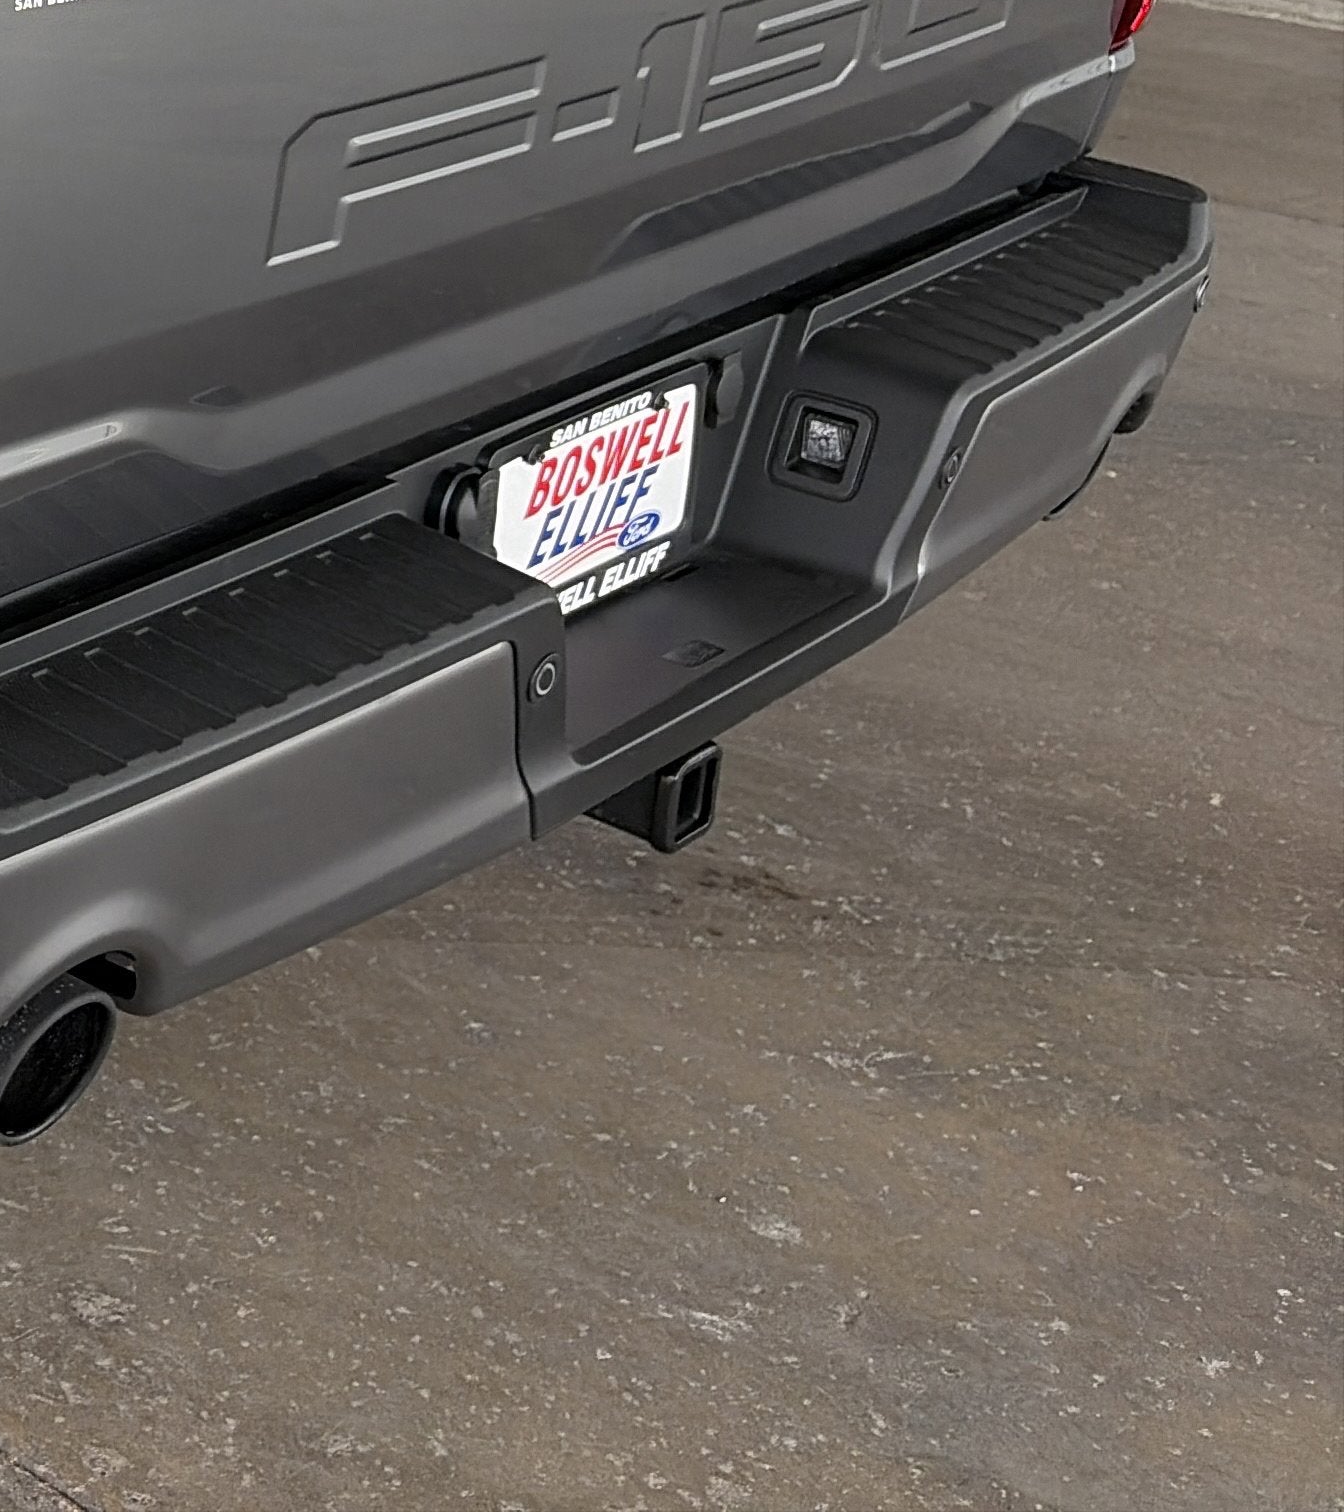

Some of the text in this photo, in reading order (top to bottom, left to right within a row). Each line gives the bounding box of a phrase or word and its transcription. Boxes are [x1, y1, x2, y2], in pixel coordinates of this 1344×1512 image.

[523, 401, 690, 520] BOSWELL
[549, 392, 653, 448] SAN BENITO
[525, 464, 660, 569] ELLIFF
[556, 541, 671, 616] ELL ELLIFF
